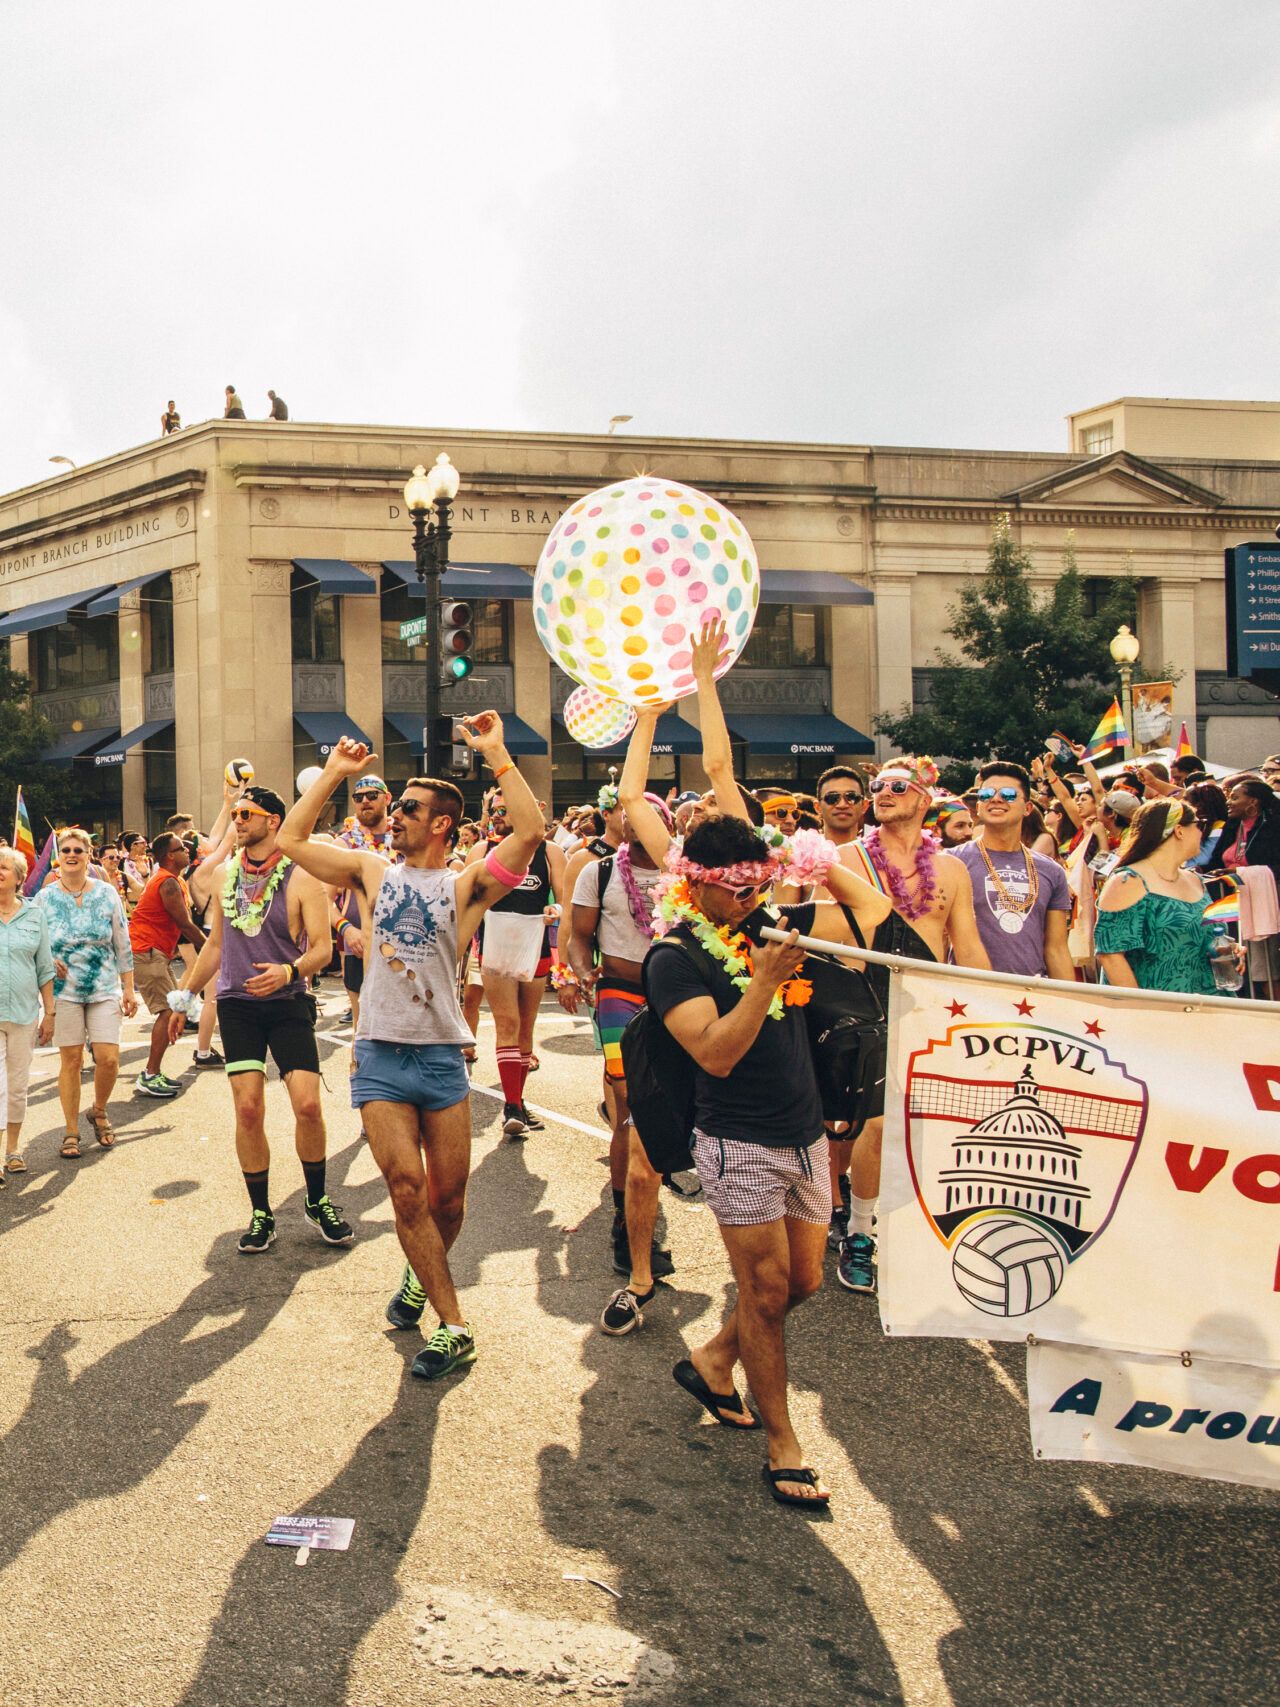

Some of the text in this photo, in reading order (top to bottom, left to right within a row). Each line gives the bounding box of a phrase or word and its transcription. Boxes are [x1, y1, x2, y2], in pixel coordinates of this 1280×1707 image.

[43, 540, 88, 564] BRANCH
[96, 518, 160, 549] BUILDING
[960, 1034, 1096, 1075] DCPVL
[1165, 1141, 1280, 1204] VO
[1049, 1378, 1102, 1416] A
